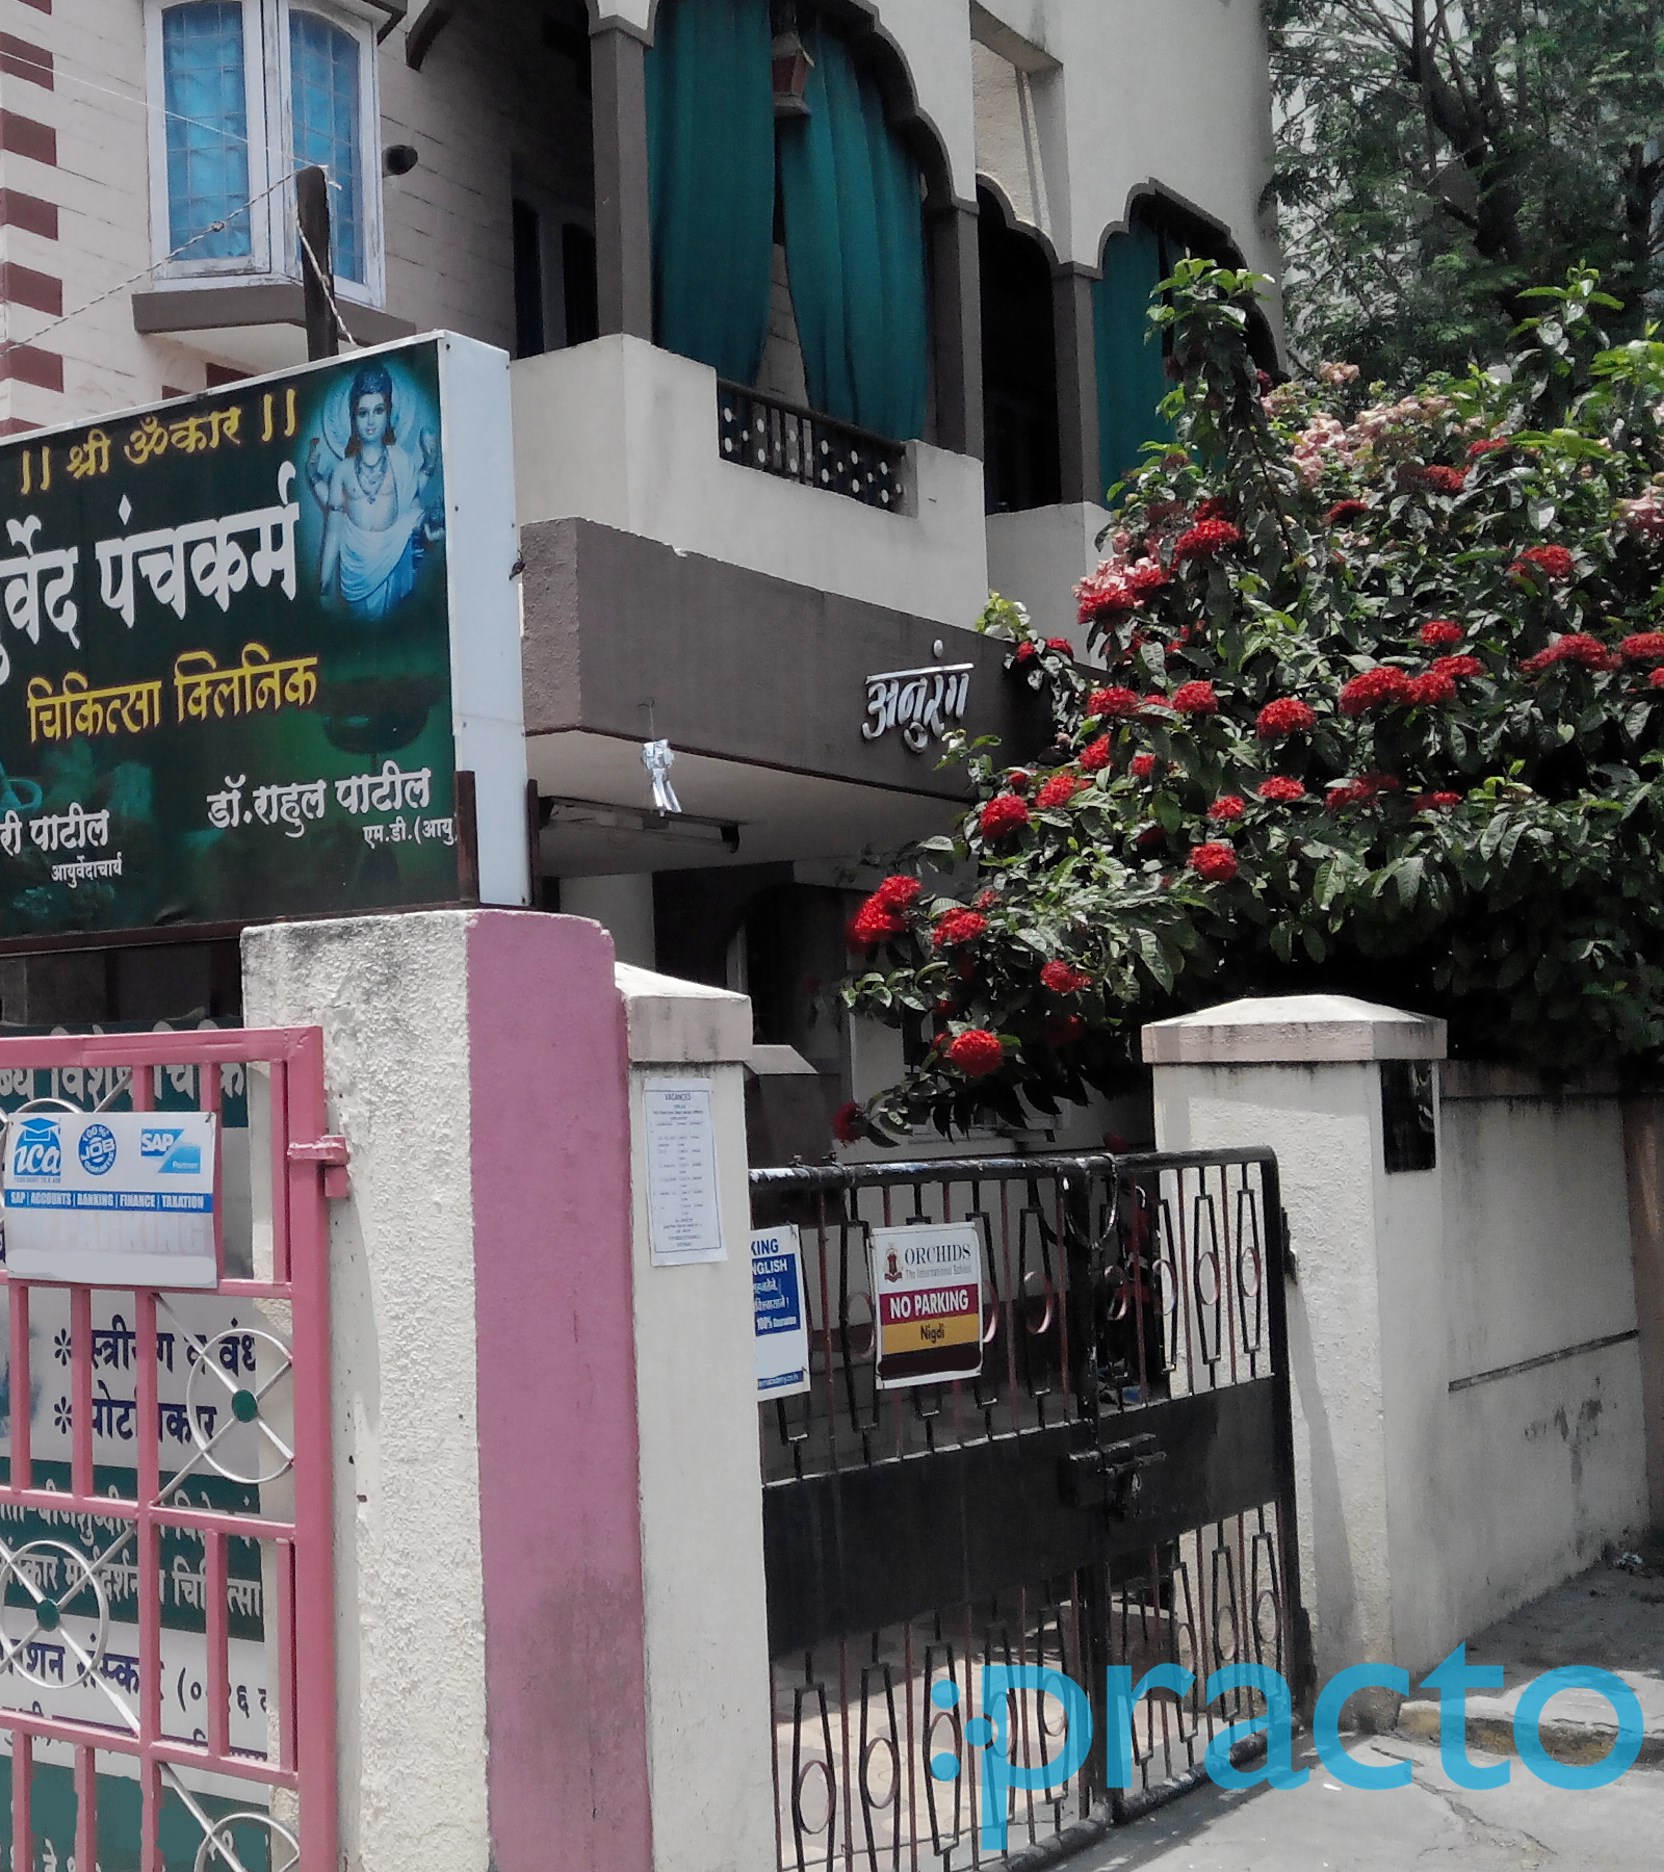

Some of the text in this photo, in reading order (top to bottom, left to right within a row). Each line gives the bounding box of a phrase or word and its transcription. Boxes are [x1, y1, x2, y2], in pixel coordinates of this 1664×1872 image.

[67, 437, 111, 481] श्री
[124, 405, 242, 465] ॐकार
[94, 459, 301, 629] पंचकर्म
[26, 643, 319, 745] चिकित्सा क्लिनिक
[861, 638, 976, 754] अनुरंग
[335, 759, 432, 815] पाटील
[29, 802, 111, 852] पाटील
[51, 851, 124, 889] आयुर्वेदाचार्य
[81, 1138, 116, 1160] JOB
[141, 1133, 174, 1152] SAP
[14, 1143, 61, 1175] ica
[11, 1192, 205, 1210] SAP ACCOUNTS BANKING FINANCE TAXATION
[904, 1243, 972, 1266] ORCHIDS
[906, 1263, 973, 1280] The International School
[889, 1289, 970, 1320] NO PARKING
[920, 1323, 946, 1343] Nigdi
